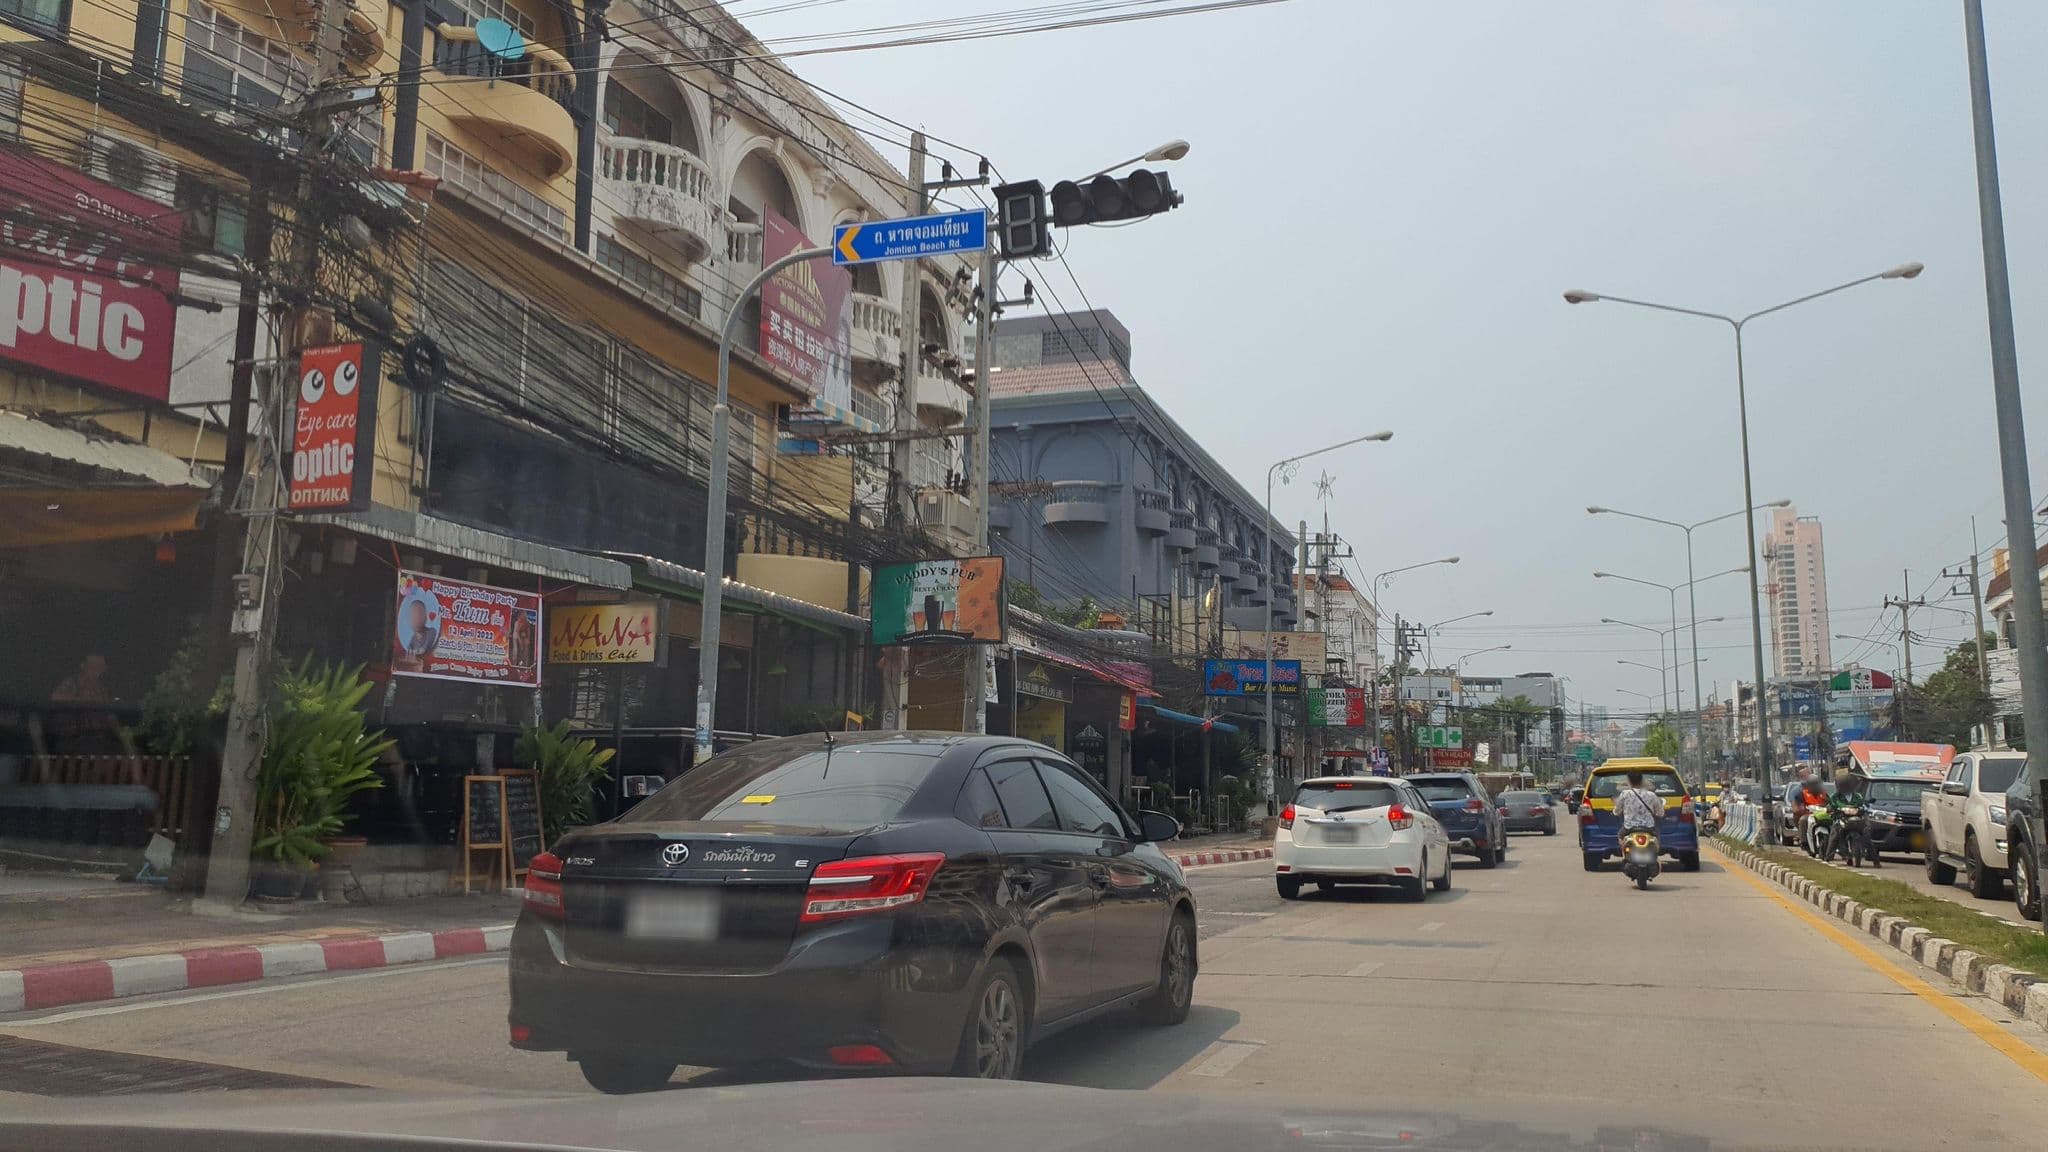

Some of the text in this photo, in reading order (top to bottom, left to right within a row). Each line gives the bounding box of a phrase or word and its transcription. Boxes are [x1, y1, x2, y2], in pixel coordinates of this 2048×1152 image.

[888, 218, 969, 241] หาดจอมเทียน
[885, 239, 962, 256] Jomtien Beach Rd.
[297, 407, 356, 447] Eye care
[293, 439, 354, 488] optic
[292, 487, 349, 504] ОПТИКА
[895, 567, 977, 584] PADDY'S PUB
[432, 582, 518, 608] Happy Birthday Party
[553, 614, 652, 647] NANA
[581, 648, 603, 661] Drinks
[607, 647, 639, 661] Café
[795, 859, 809, 868] E
